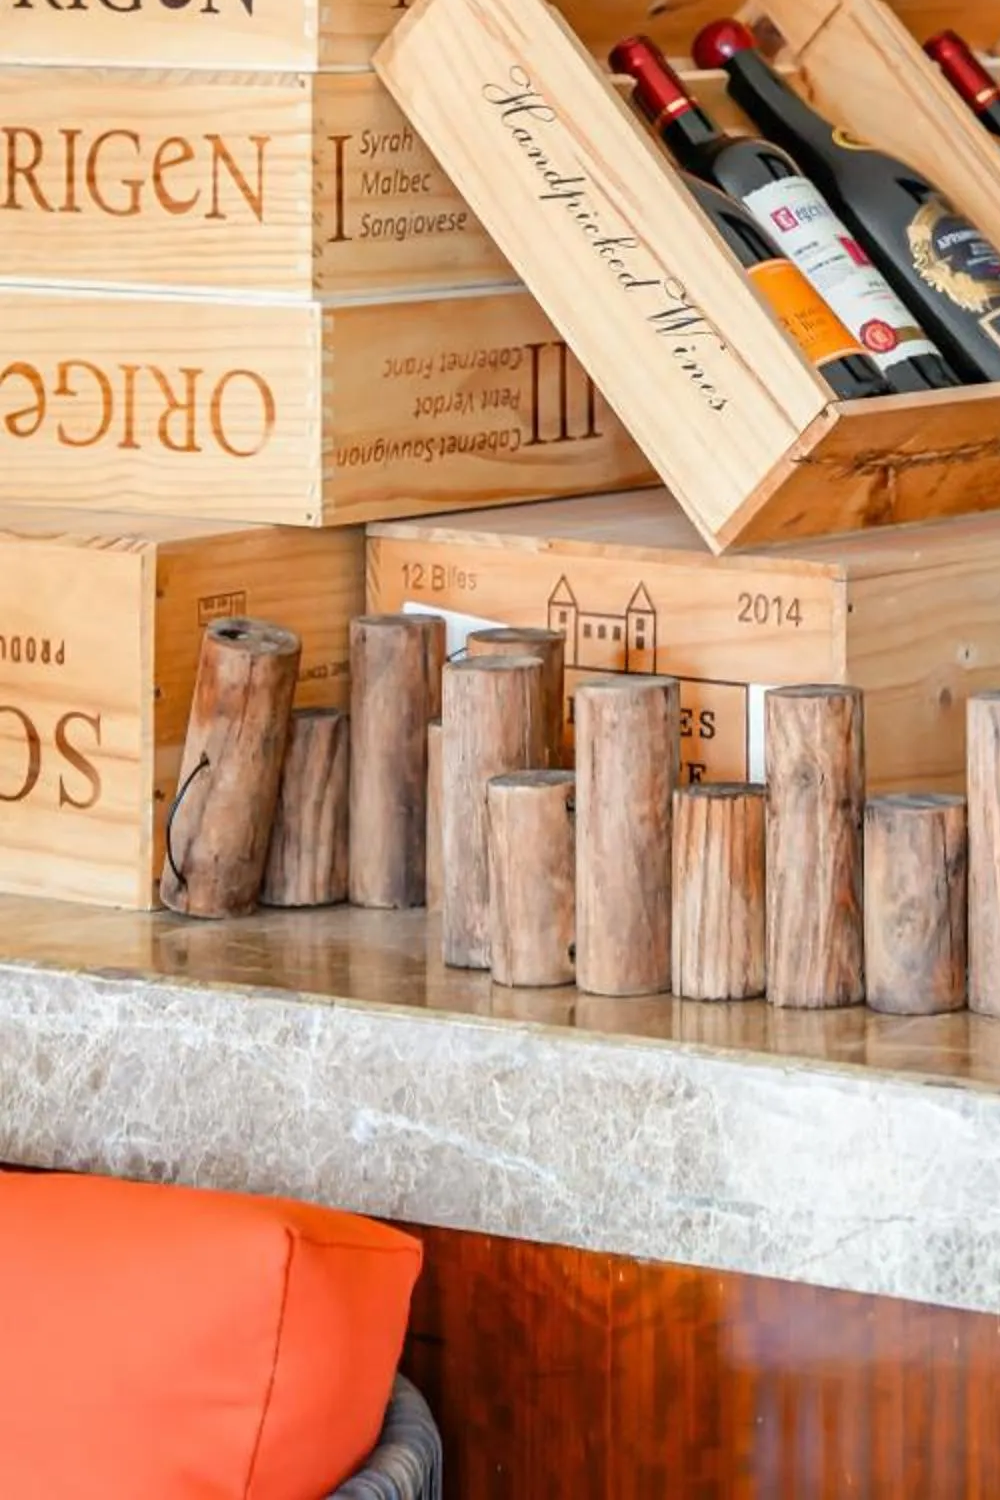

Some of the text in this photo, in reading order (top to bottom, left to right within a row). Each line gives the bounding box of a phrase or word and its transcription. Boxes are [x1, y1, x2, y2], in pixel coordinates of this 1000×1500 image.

[360, 130, 413, 158] Syrah
[361, 170, 431, 196] Malbec
[359, 208, 467, 242] Sangiovese
[481, 65, 729, 413] Handpicked Wines
[383, 346, 523, 380] Cabernet Franc
[413, 387, 521, 419] Petit Verdot
[336, 439, 435, 467] Sauvignon
[439, 427, 521, 457] Cabernet
[401, 563, 425, 591] 12
[737, 592, 803, 628] 2014
